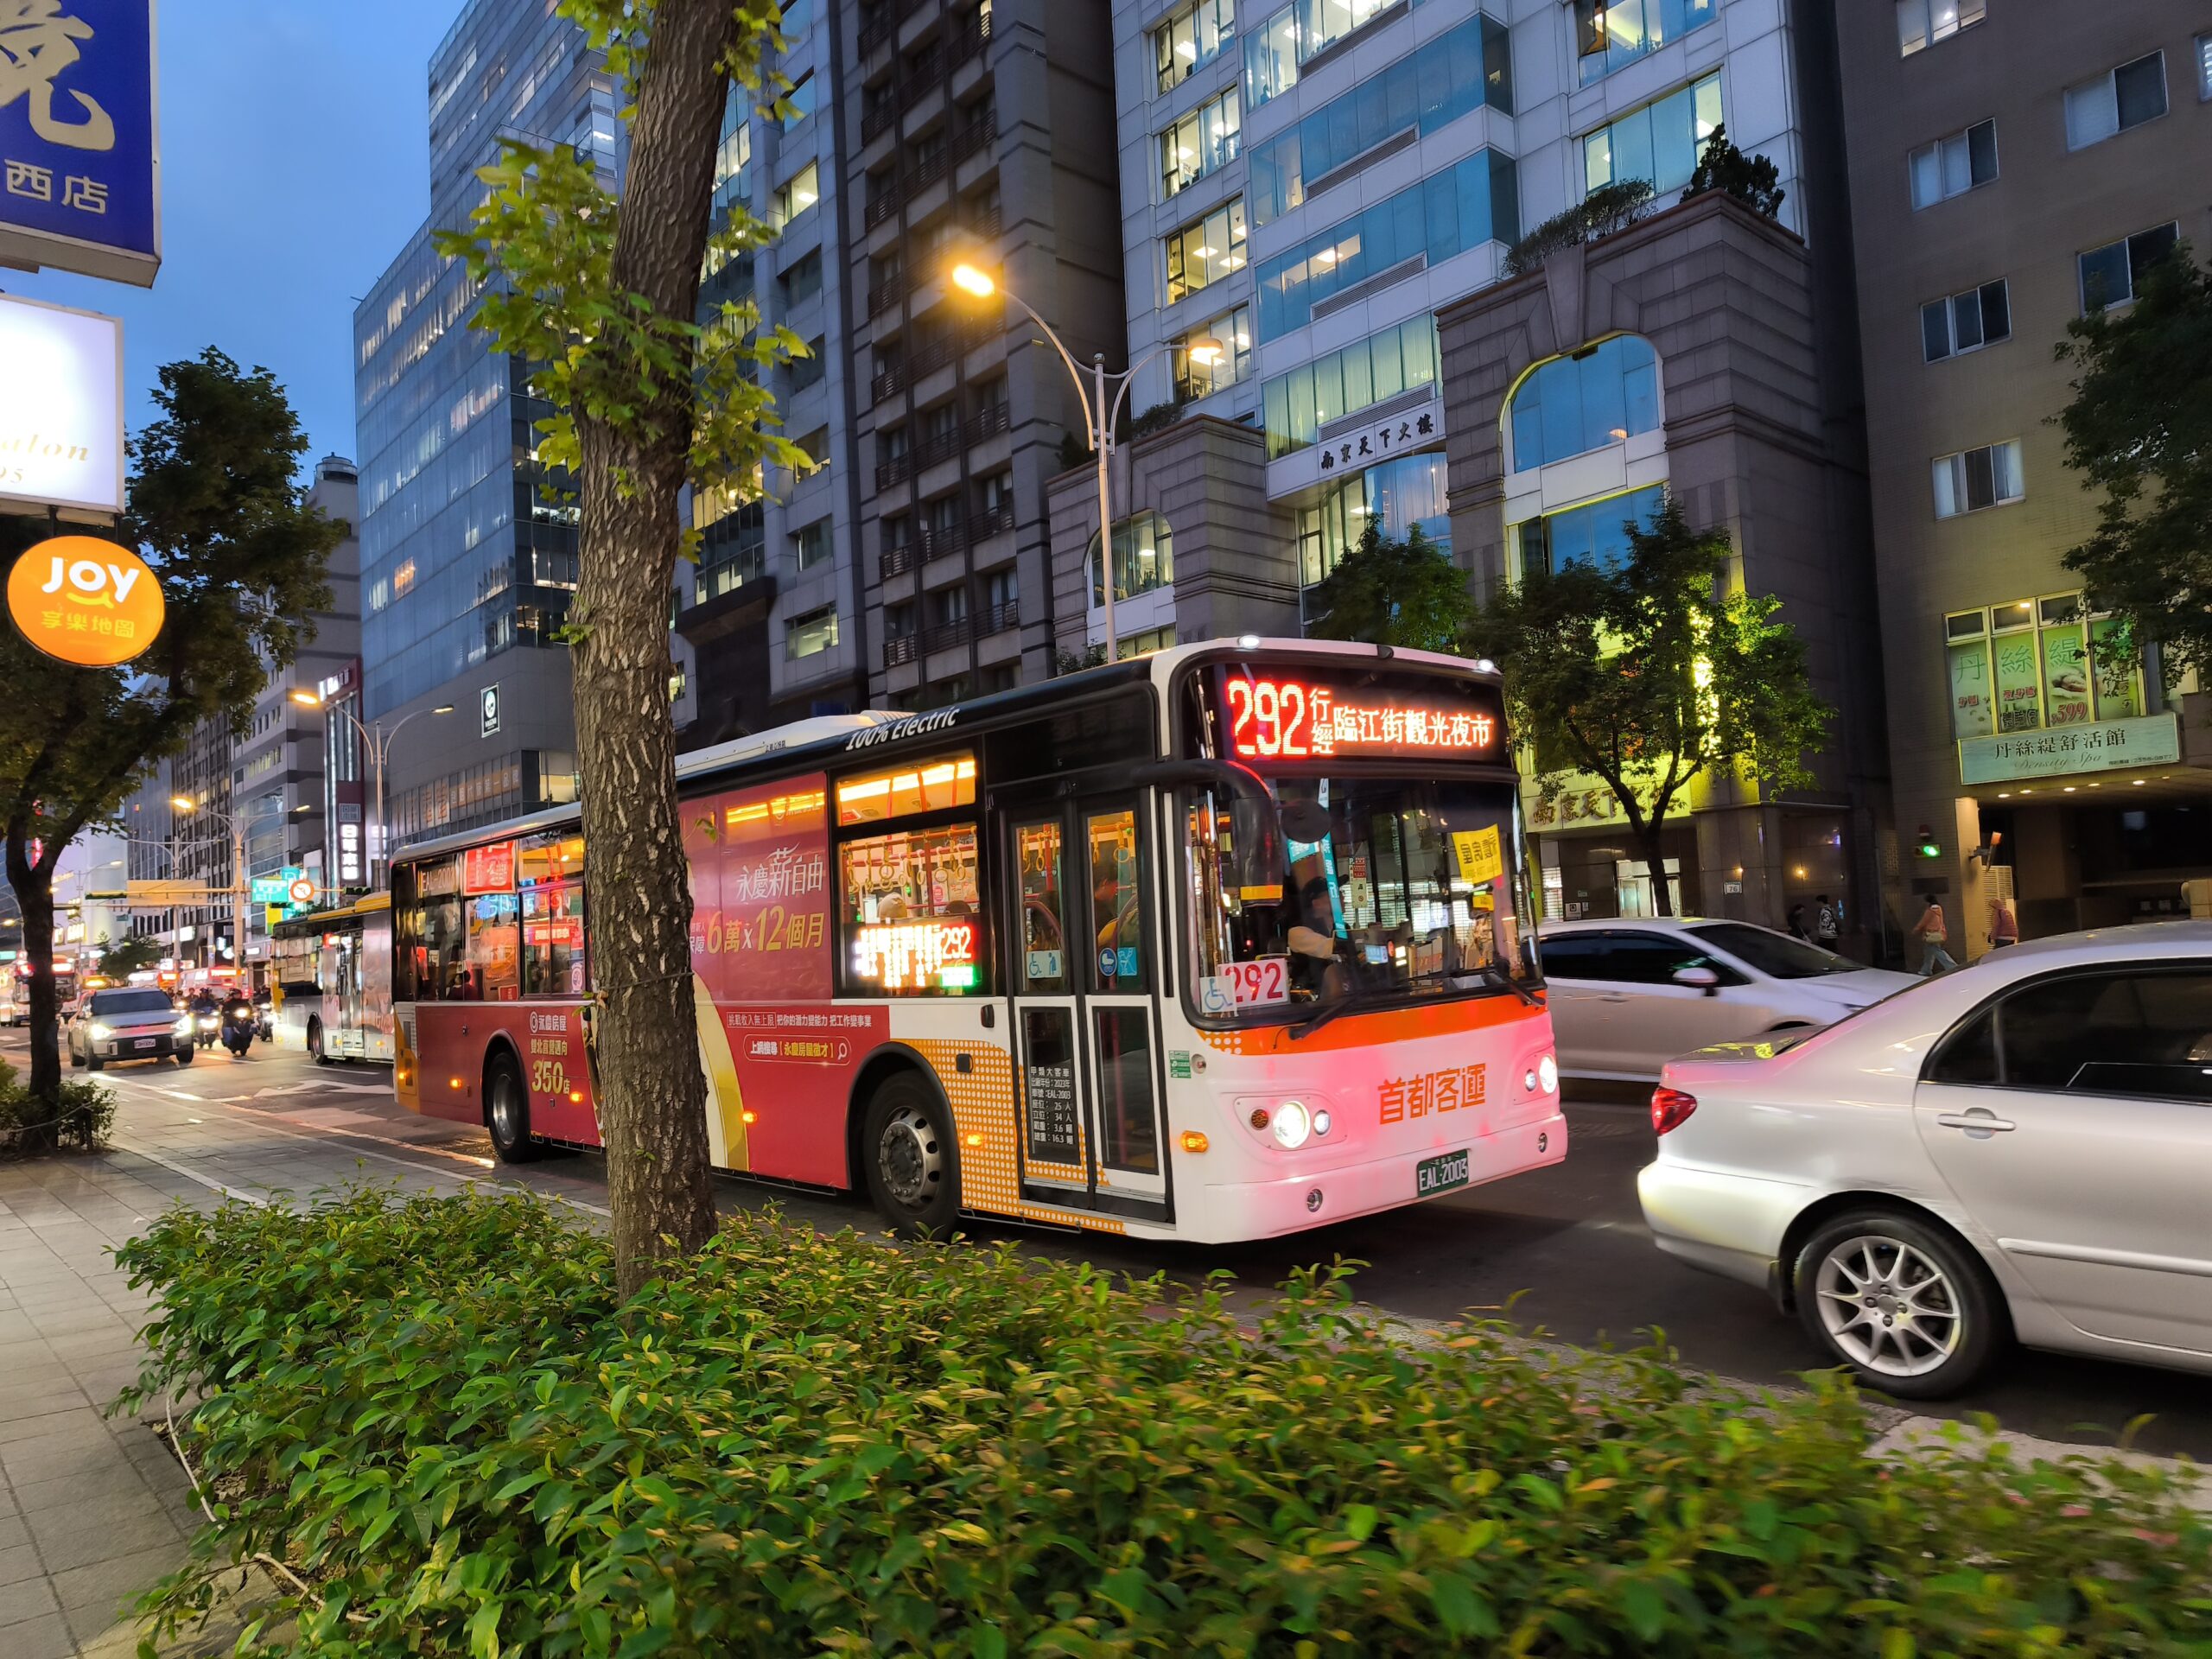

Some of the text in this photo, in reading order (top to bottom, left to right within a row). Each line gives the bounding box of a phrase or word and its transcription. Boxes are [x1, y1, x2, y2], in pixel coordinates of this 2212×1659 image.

[4, 159, 109, 215] 西店
[1321, 413, 1433, 469] 南京天下大樓
[41, 556, 140, 603] JOY
[41, 610, 135, 639] 享樂地圖
[845, 706, 961, 752] 100% Electric
[1227, 679, 1492, 755] 292 行經 臨江街觀光夜市
[1994, 728, 2126, 760] 丹絲緹舒活館
[941, 926, 972, 959] 292
[1225, 962, 1283, 1003] 292
[538, 1014, 568, 1032] 永慶房屋
[1377, 1063, 1486, 1125] 首都客運
[1418, 1158, 1469, 1192] EAL-2003
